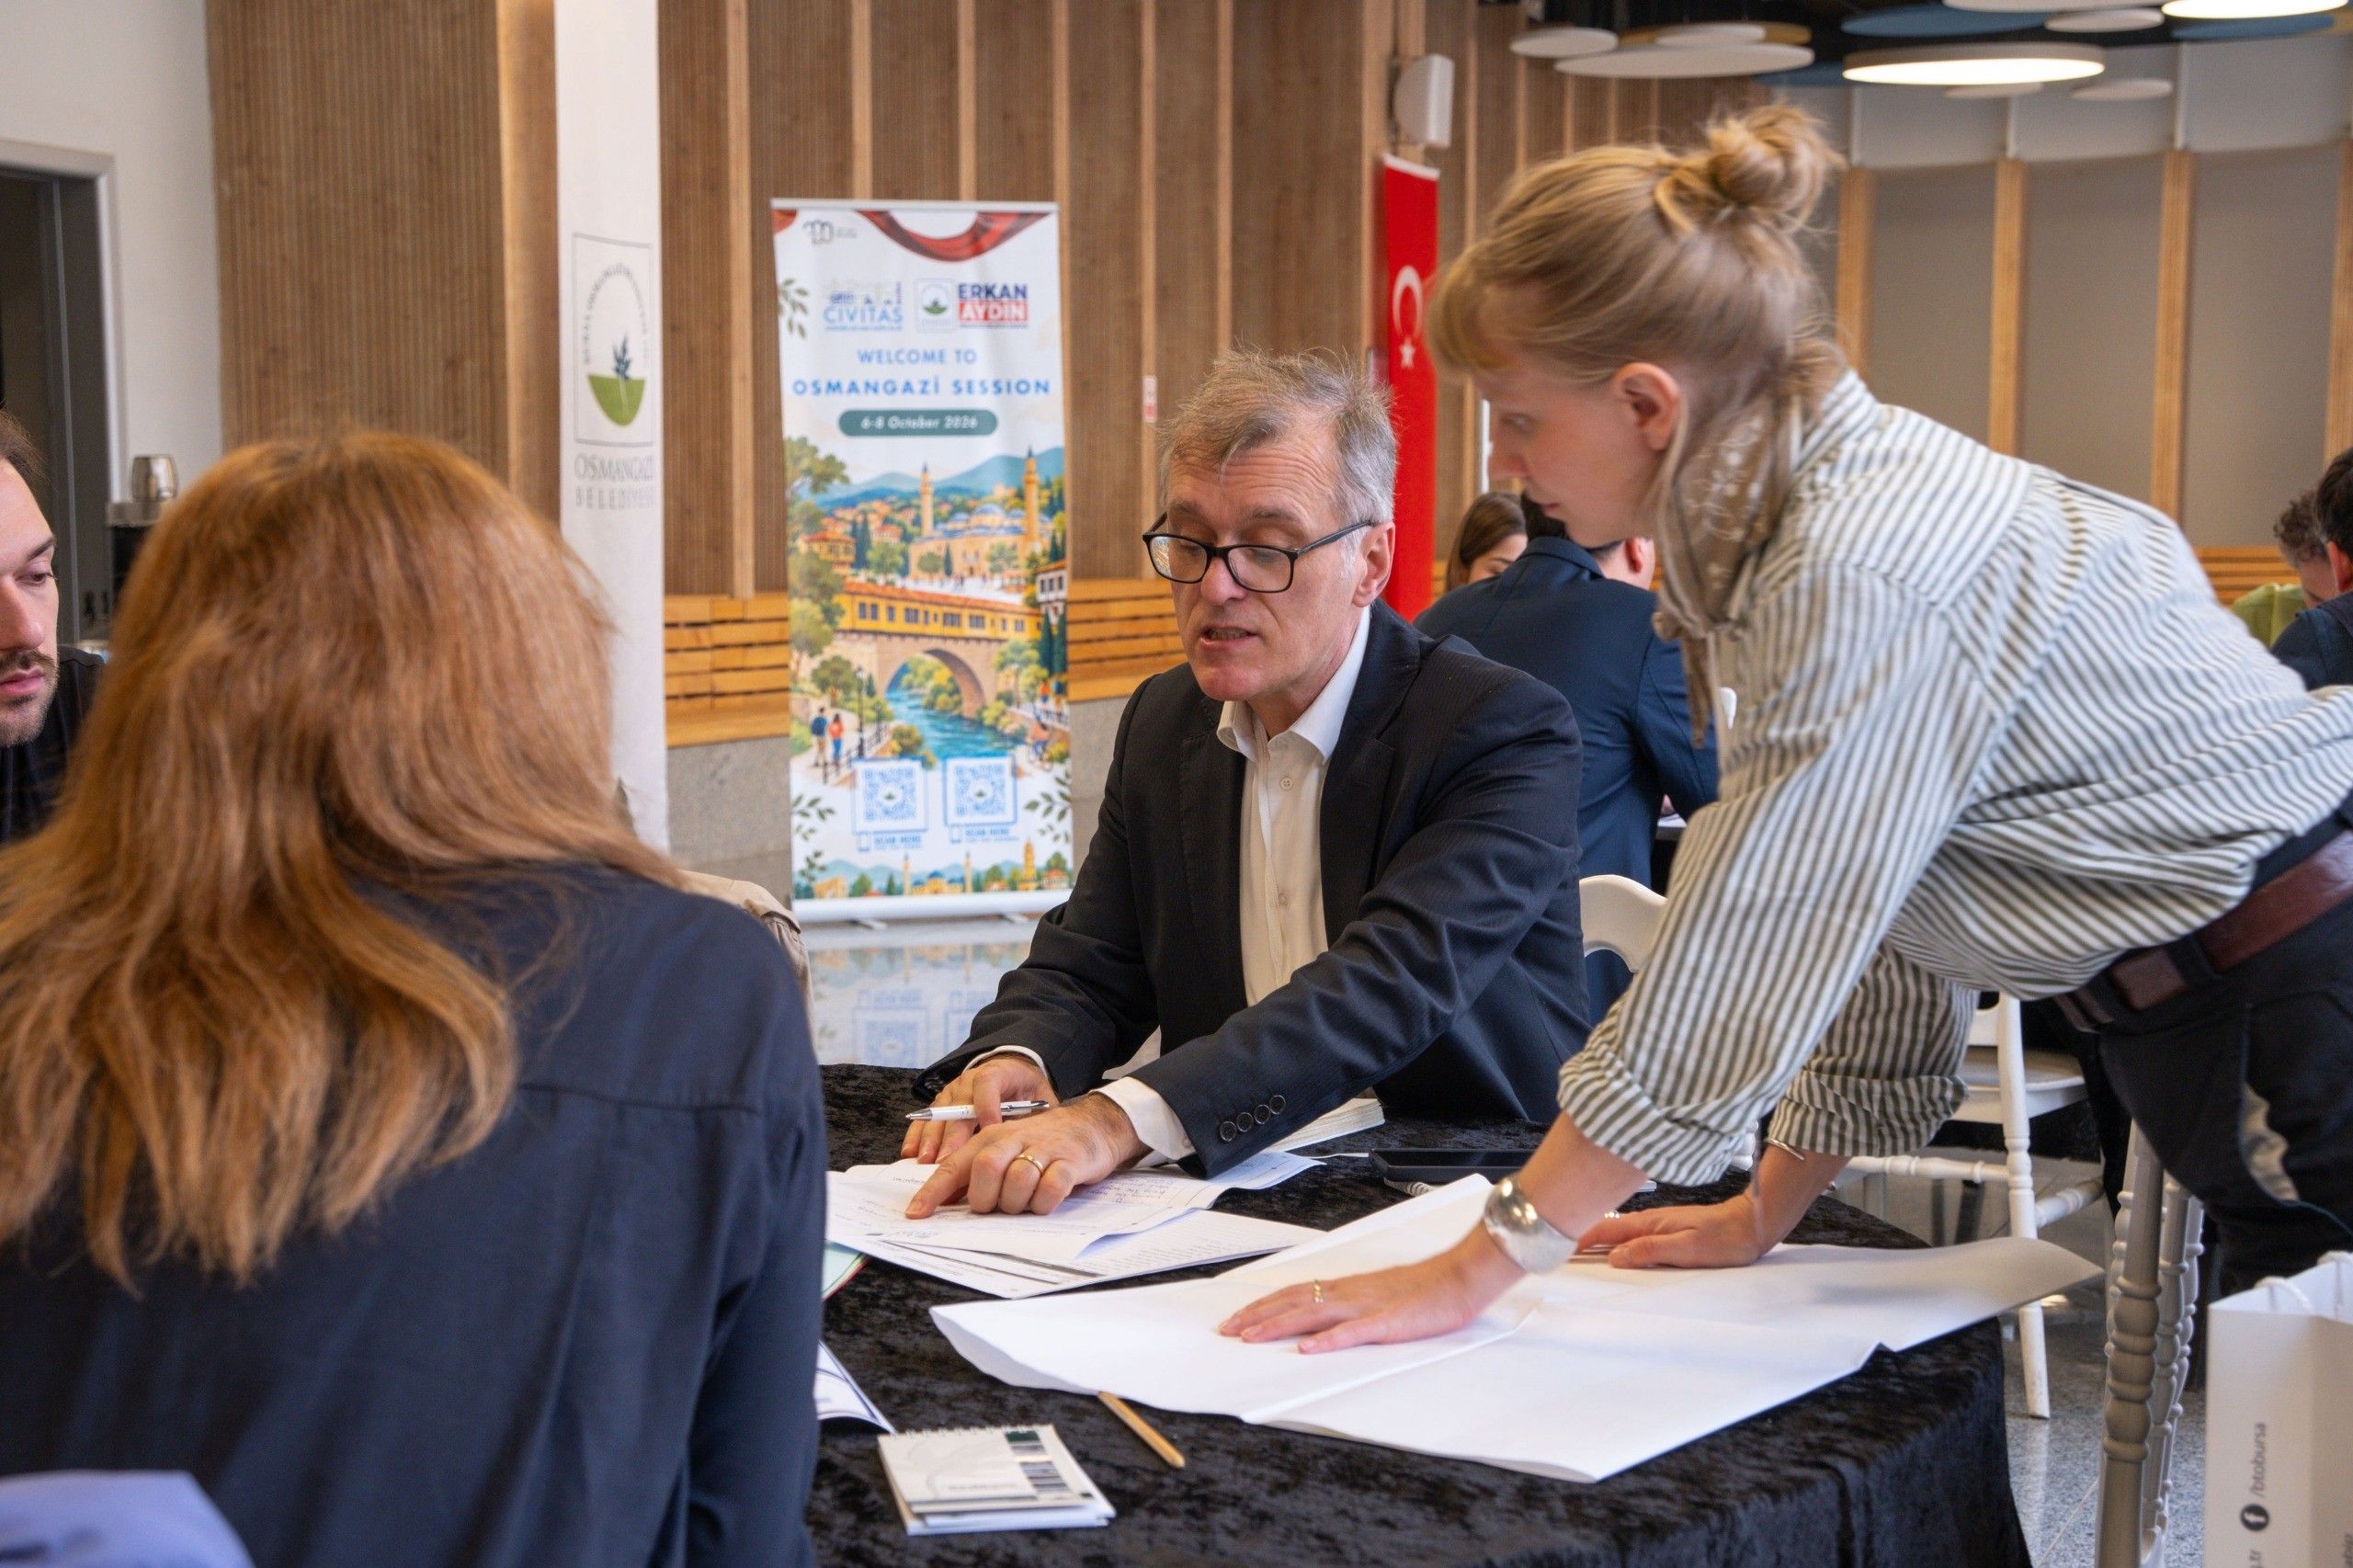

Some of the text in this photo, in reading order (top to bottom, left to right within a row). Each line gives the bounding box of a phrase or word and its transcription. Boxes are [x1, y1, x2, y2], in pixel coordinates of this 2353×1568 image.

[958, 283, 1029, 300] ERKAN
[823, 303, 904, 324] CIVITAS
[960, 301, 1028, 322] AYDIN
[857, 348, 978, 365] WELCOME TO
[791, 375, 1051, 395] OSMANGAZİ SESSION
[887, 414, 941, 430] October
